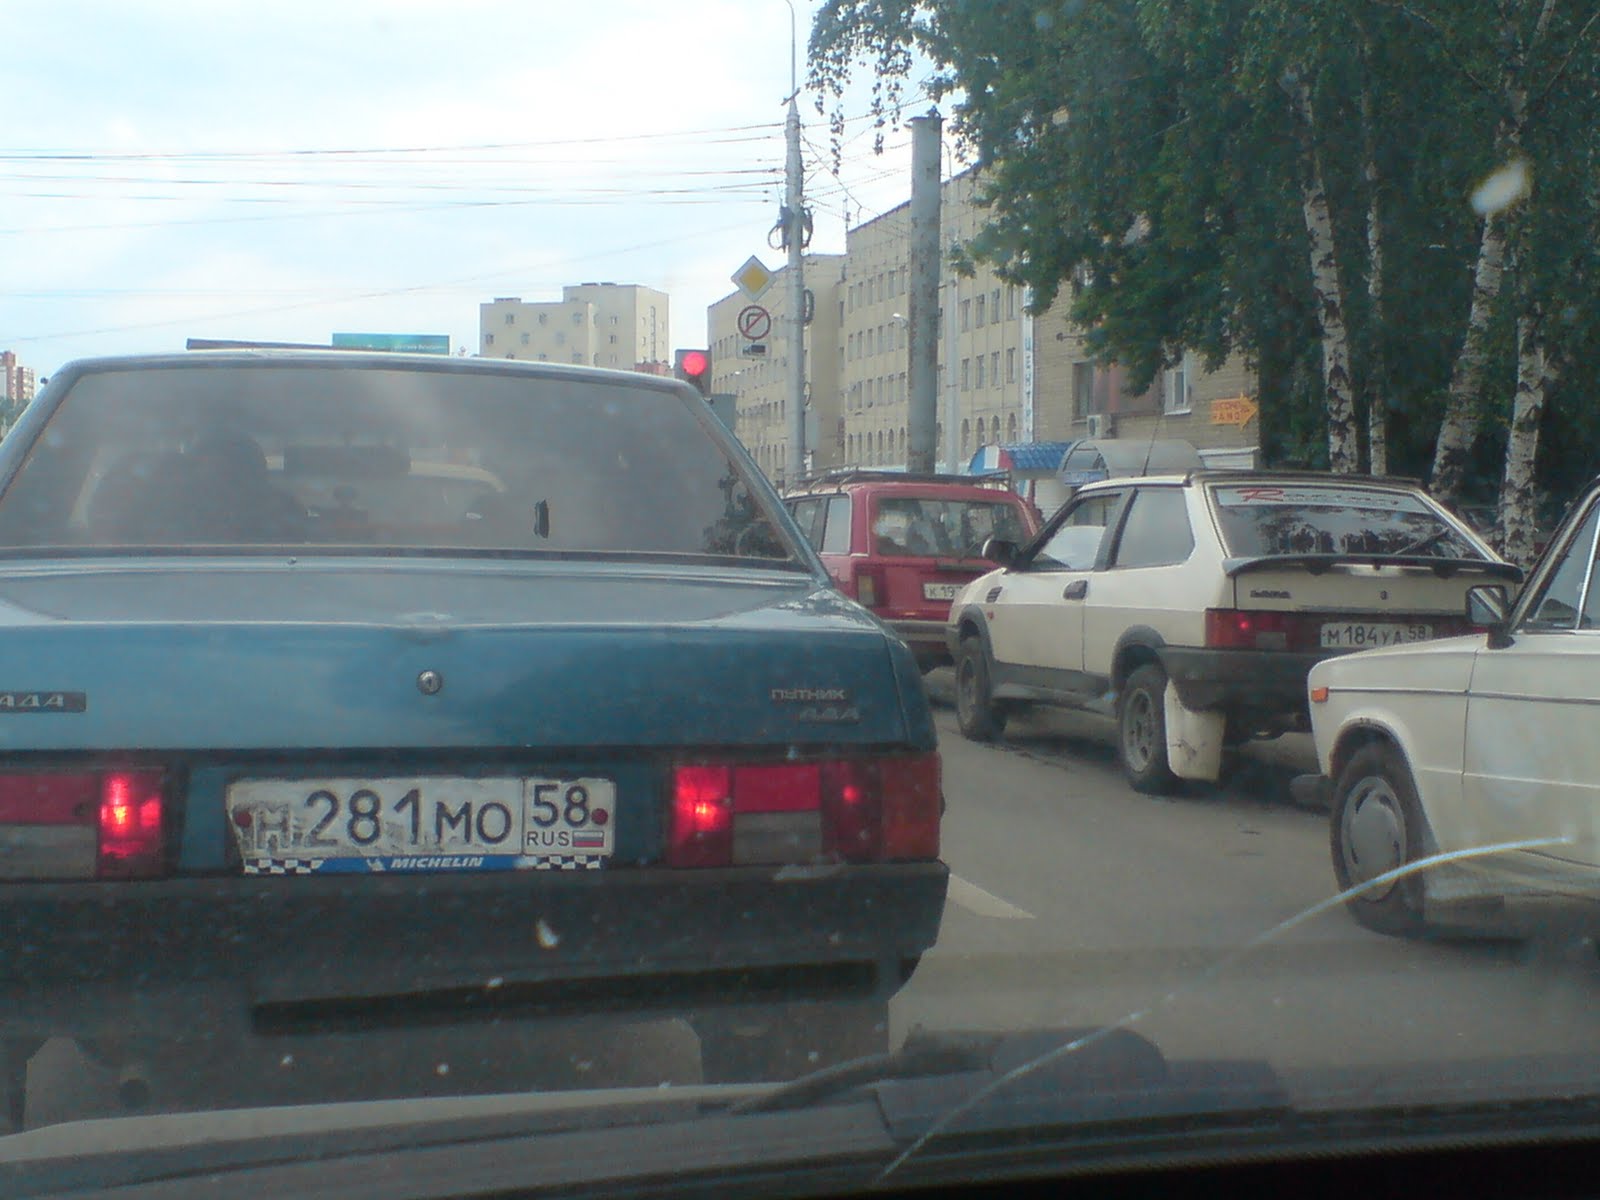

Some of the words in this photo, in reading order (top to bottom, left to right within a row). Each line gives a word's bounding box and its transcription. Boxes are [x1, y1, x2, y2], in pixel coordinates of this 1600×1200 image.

[1407, 625, 1426, 641] 58
[532, 784, 590, 828] 58
[526, 830, 570, 847] RUS
[390, 857, 484, 869] MICHELIN
